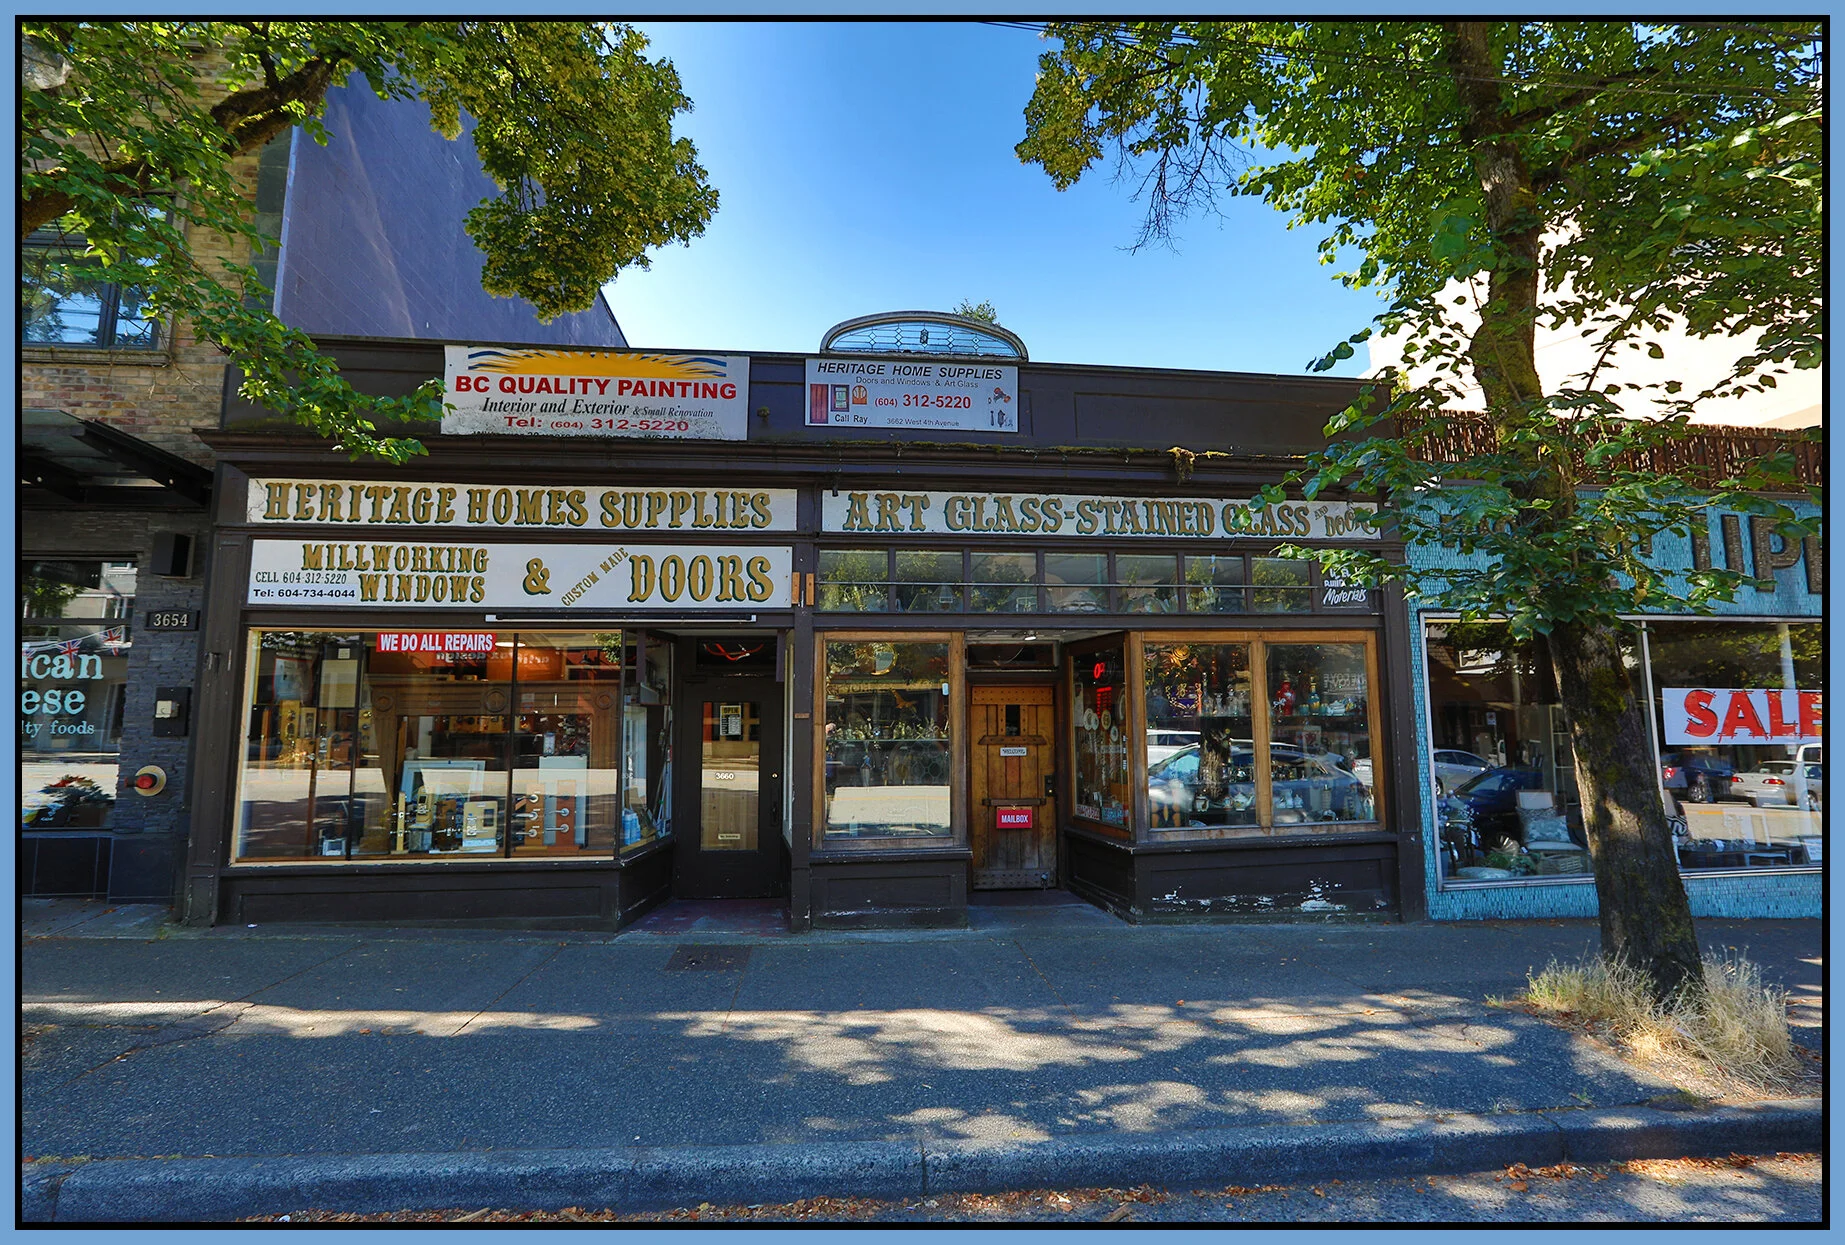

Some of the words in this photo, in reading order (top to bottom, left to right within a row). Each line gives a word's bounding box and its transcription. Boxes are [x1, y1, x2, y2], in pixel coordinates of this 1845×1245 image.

[817, 362, 886, 375] HERITAGE
[892, 366, 932, 377] HOME
[938, 367, 1003, 380] SUPPLIES
[455, 376, 490, 393] BC
[498, 377, 611, 396] QUALITY
[617, 379, 737, 399] PAINTING
[855, 376, 879, 385] Doors
[880, 377, 895, 386] and
[896, 377, 931, 388] Windows
[944, 380, 956, 388] Art
[957, 381, 979, 389] Glass
[482, 397, 537, 413] Interior
[540, 398, 567, 413] and
[572, 399, 629, 416] Exterior
[874, 397, 898, 408] (604)
[902, 394, 972, 409] 312-5220
[632, 406, 640, 416] &
[642, 406, 666, 416] Small
[668, 407, 714, 418] Renovation
[834, 413, 850, 423] Call
[853, 415, 868, 425] Ray
[504, 416, 542, 428] Tel:
[550, 421, 583, 430] (604)
[591, 418, 689, 432] 312-5220
[904, 418, 923, 426] West
[922, 418, 935, 427] 4th
[935, 419, 960, 428] Avenue
[263, 482, 456, 524] HERITAGE
[466, 488, 589, 527] HOMES
[600, 490, 773, 529] SUPPLIES
[842, 492, 931, 532] ART
[1221, 503, 1311, 537] GLASS
[301, 544, 489, 572] MILLWORKING
[255, 571, 280, 583] CELL
[282, 572, 347, 585] 604-312-5220
[523, 557, 552, 596] &
[561, 571, 600, 607] CUSTOM
[599, 547, 629, 574] MADE
[627, 554, 775, 603] DOORS
[253, 588, 275, 598] Tel:
[277, 588, 356, 598] 604-734-4044
[357, 573, 486, 603] WINDOWS
[1323, 588, 1367, 606] Materials
[153, 613, 189, 628] 3654
[380, 634, 399, 651] WE
[401, 634, 418, 651] DO
[420, 634, 442, 651] ALL
[445, 634, 493, 651] REPAIRS
[1683, 689, 1822, 743] SALE
[50, 720, 95, 735] foods
[715, 772, 735, 780] 3660
[1001, 815, 1029, 823] MAILBOX
